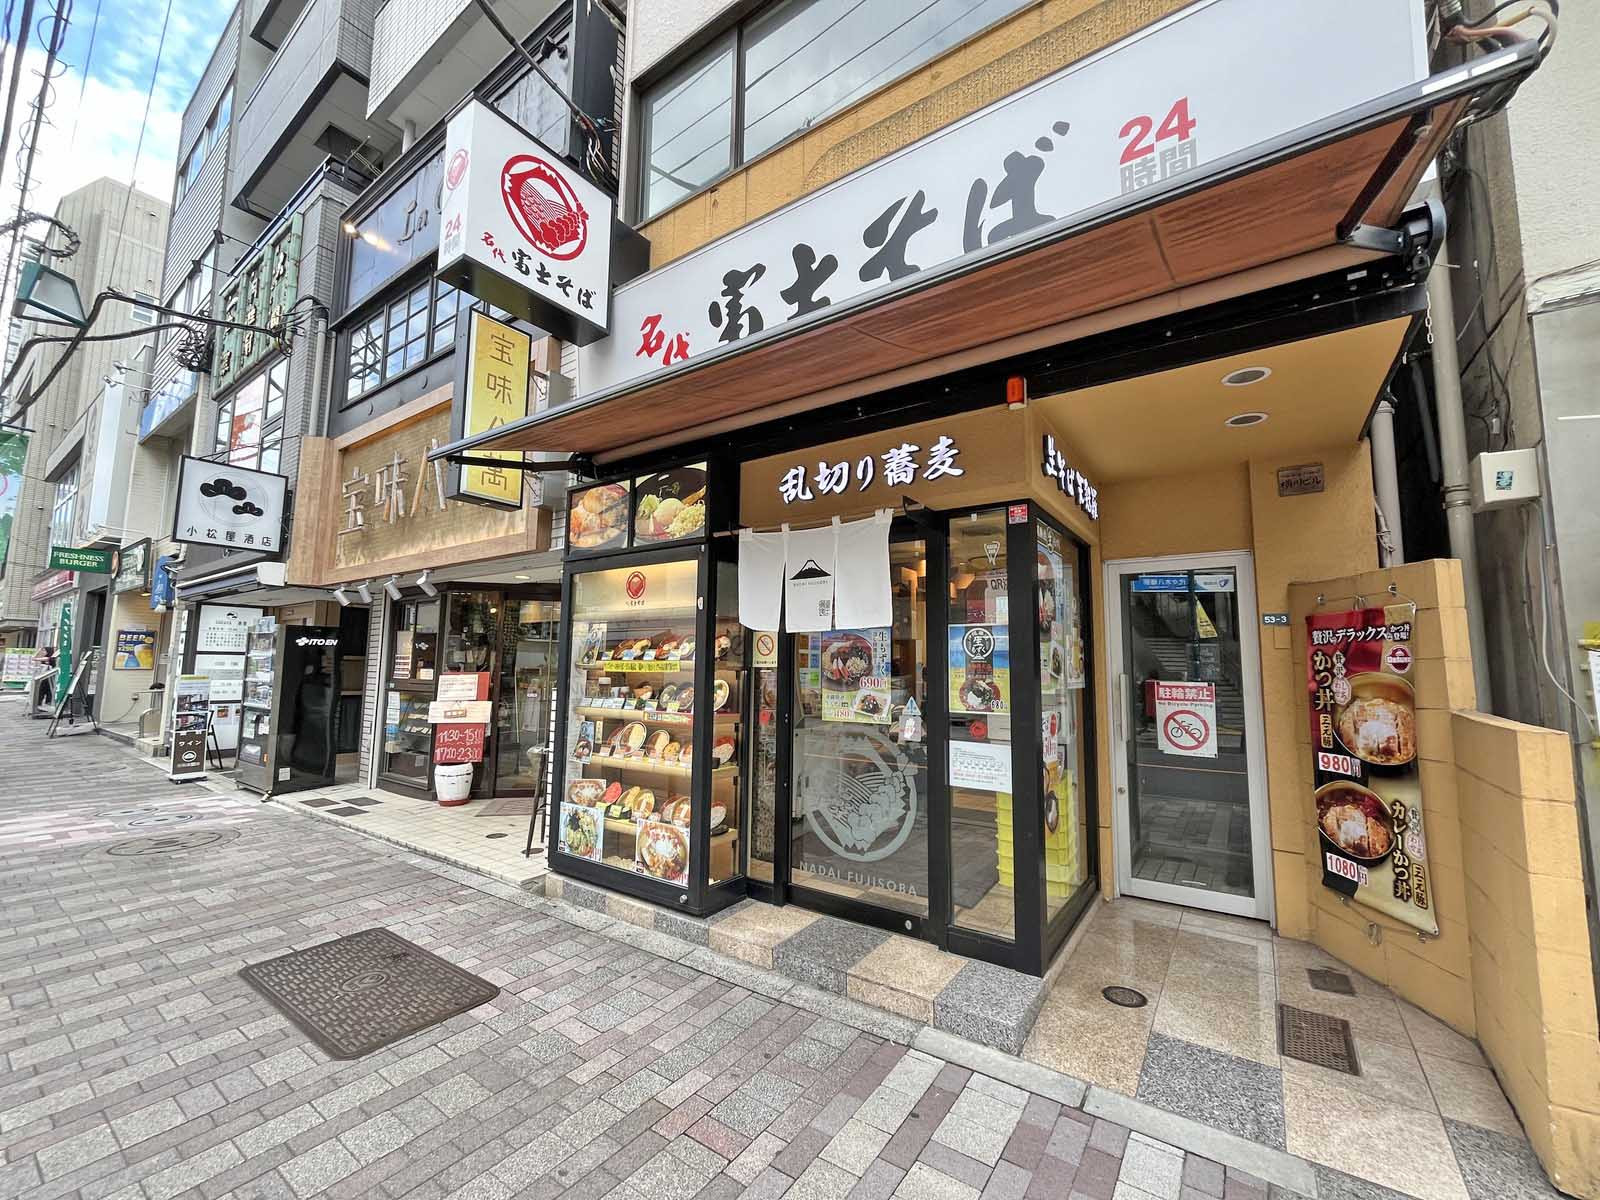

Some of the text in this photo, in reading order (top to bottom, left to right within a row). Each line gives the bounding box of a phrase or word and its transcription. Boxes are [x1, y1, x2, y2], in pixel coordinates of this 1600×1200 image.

[1119, 97, 1197, 165] 24
[1120, 139, 1198, 195] 時間
[444, 213, 462, 240] 24
[779, 435, 964, 504] 乱切り蕎麦
[186, 525, 273, 548] 小松屋酒店
[54, 550, 105, 563] FRESHNESS
[59, 558, 98, 568] BURGER
[1264, 614, 1287, 624] 53-3
[119, 633, 147, 642] BEER
[1158, 687, 1212, 700] 駐輪禁止
[1314, 650, 1335, 712] かつ丼
[178, 739, 203, 747] ワイン
[1392, 801, 1412, 902] カレーかつ丼
[799, 860, 918, 898] NADAI FUJISOBA
